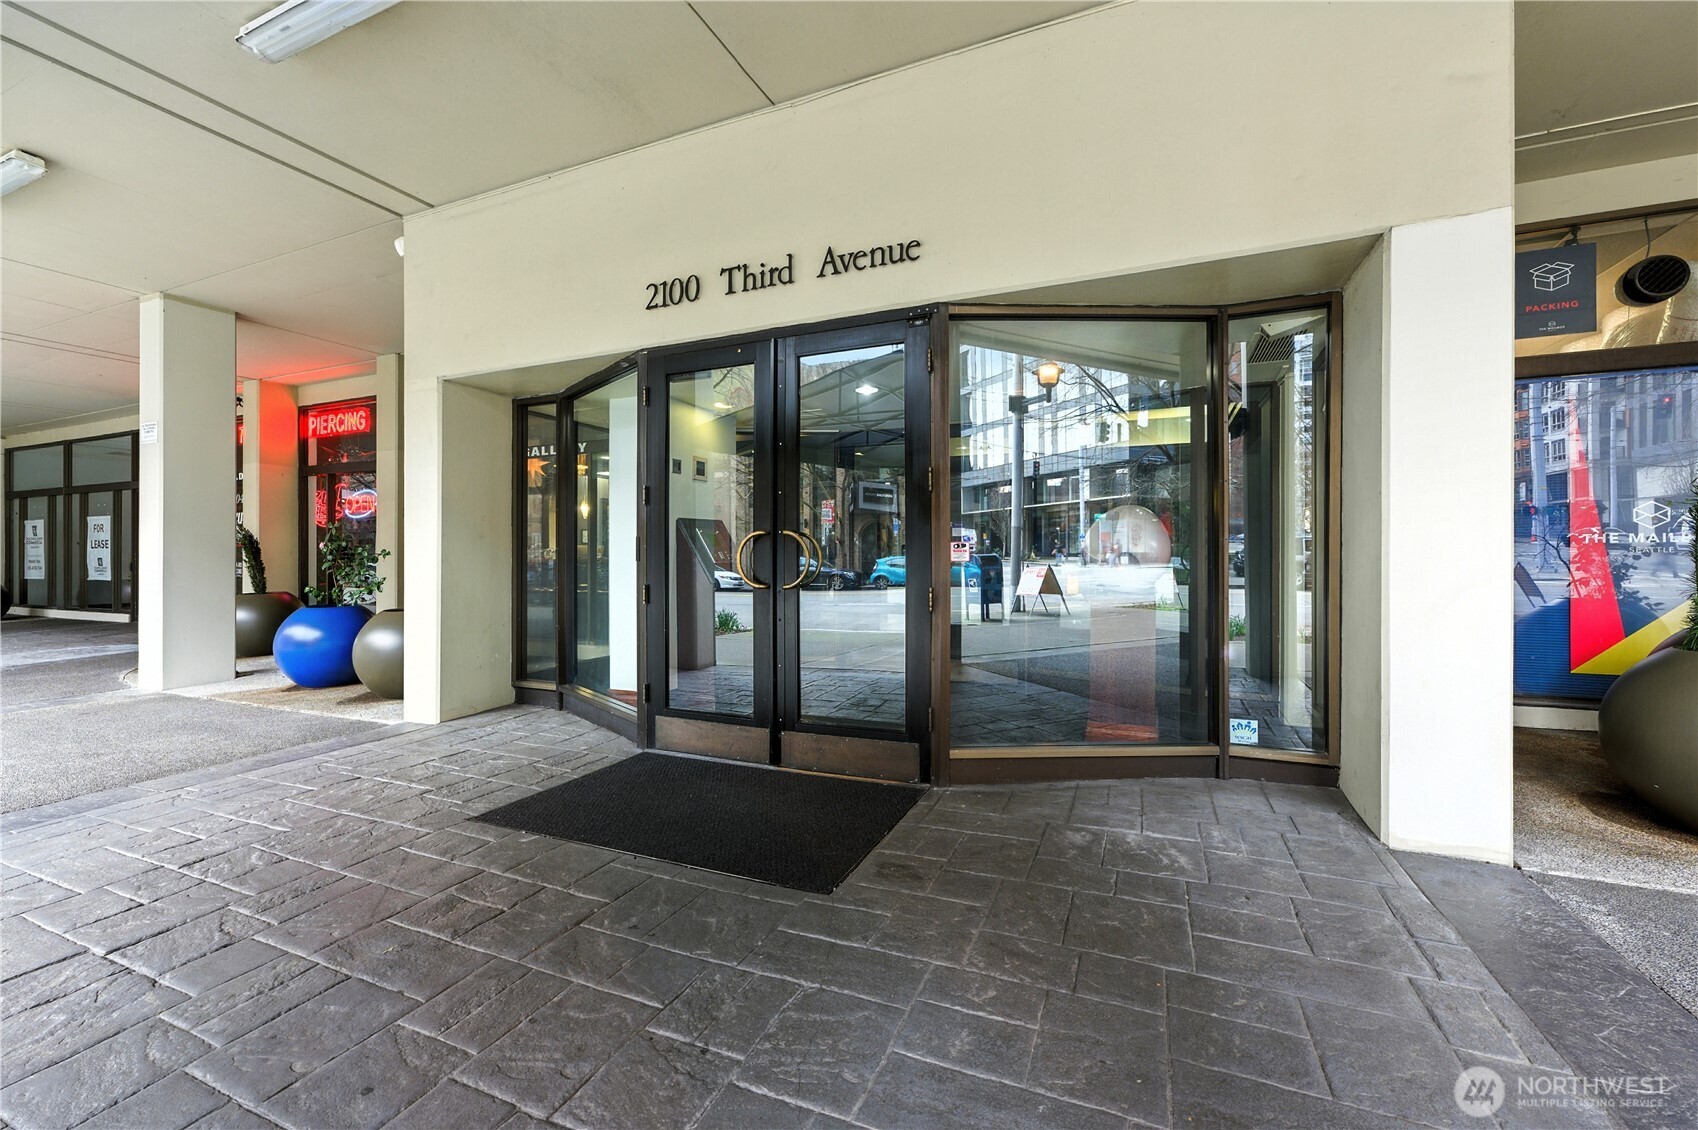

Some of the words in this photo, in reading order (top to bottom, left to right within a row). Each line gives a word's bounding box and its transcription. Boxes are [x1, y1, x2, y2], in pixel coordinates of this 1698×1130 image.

[645, 274, 701, 310] 2100
[719, 254, 795, 295] Third
[816, 239, 921, 278] Avenue
[1525, 300, 1579, 313] PACKING
[308, 410, 367, 438] PIERCING
[528, 442, 587, 457] ALLY
[345, 494, 376, 513] OPEN
[93, 523, 105, 533] FOR
[90, 539, 109, 549] LEASE
[1583, 532, 1620, 544] THE
[1629, 532, 1693, 544] MAILB
[1629, 546, 1675, 554] SEATTLE
